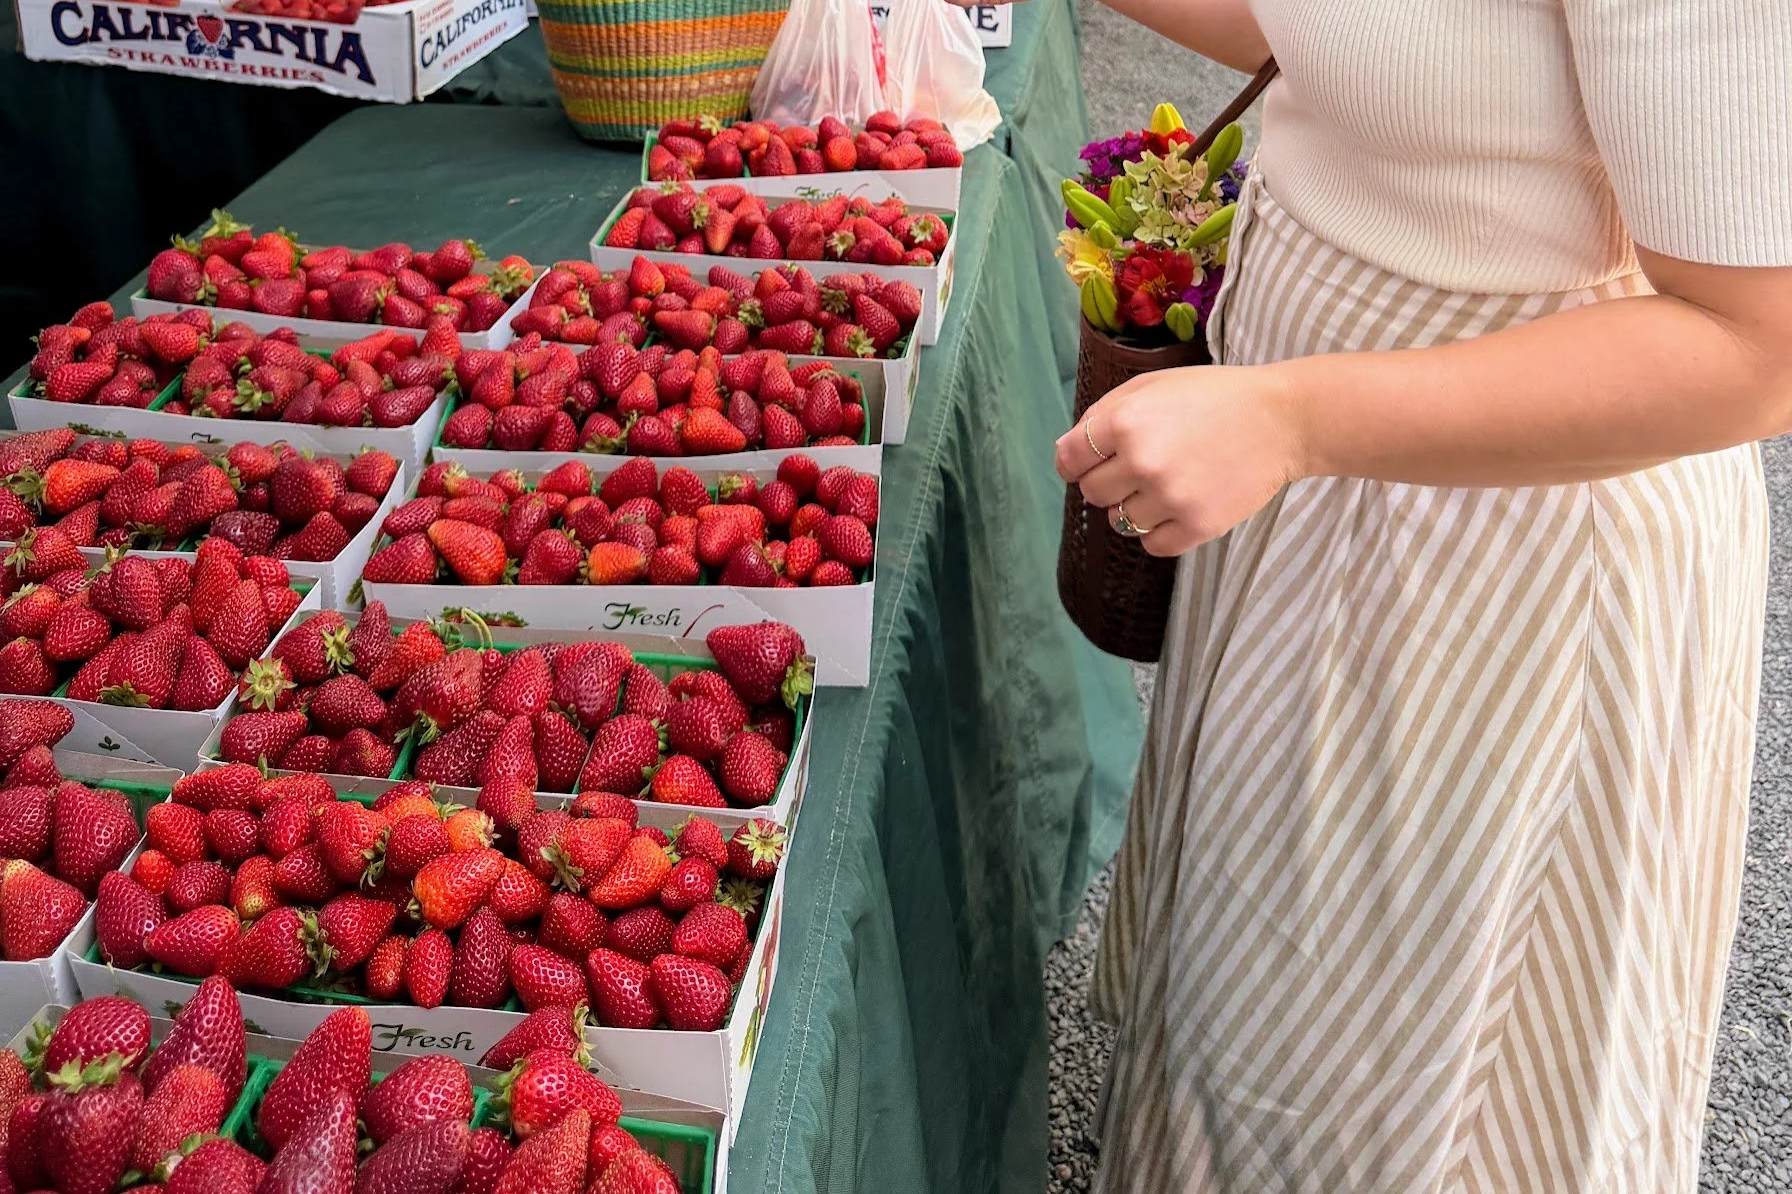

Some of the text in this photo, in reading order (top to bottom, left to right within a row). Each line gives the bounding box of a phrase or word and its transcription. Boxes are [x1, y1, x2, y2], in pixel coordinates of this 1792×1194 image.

[108, 46, 326, 83] STRAWBERRIES
[602, 602, 682, 630] Fresh
[370, 1023, 475, 1052] Fresh
